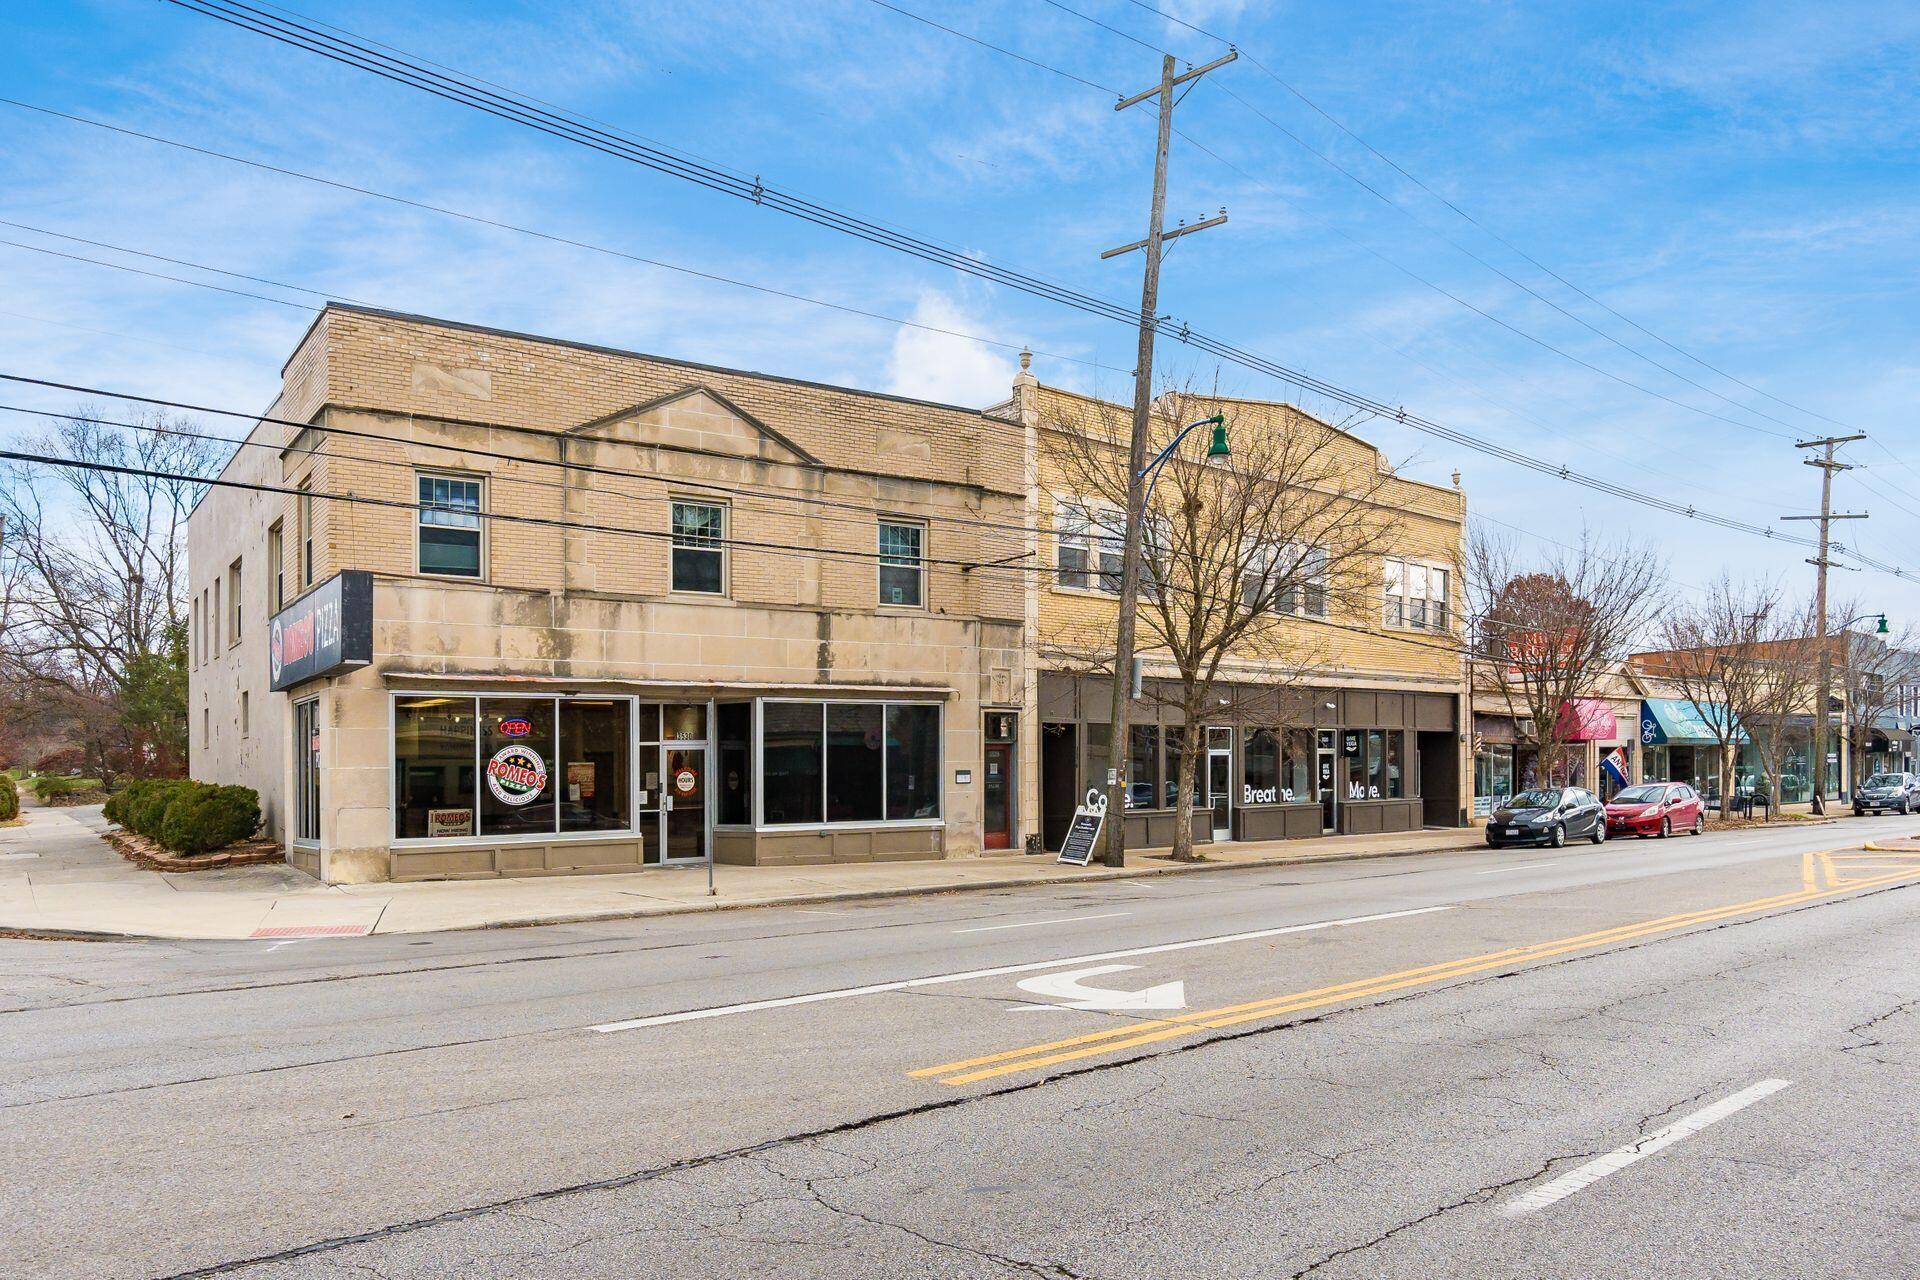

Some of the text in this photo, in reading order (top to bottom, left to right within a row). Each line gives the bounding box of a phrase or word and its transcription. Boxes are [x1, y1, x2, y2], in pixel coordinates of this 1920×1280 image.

[316, 599, 340, 651] PIZZA
[440, 725, 493, 736] HAPPINSS
[500, 722, 532, 733] OPEN
[498, 748, 543, 770] AWARD WINNING
[487, 758, 548, 791] ROMEO'S
[492, 783, 535, 802] AND DELICIOUS
[500, 778, 528, 791] PIZZA
[1086, 788, 1134, 809] Coe.
[434, 811, 471, 824] ROMEO'S
